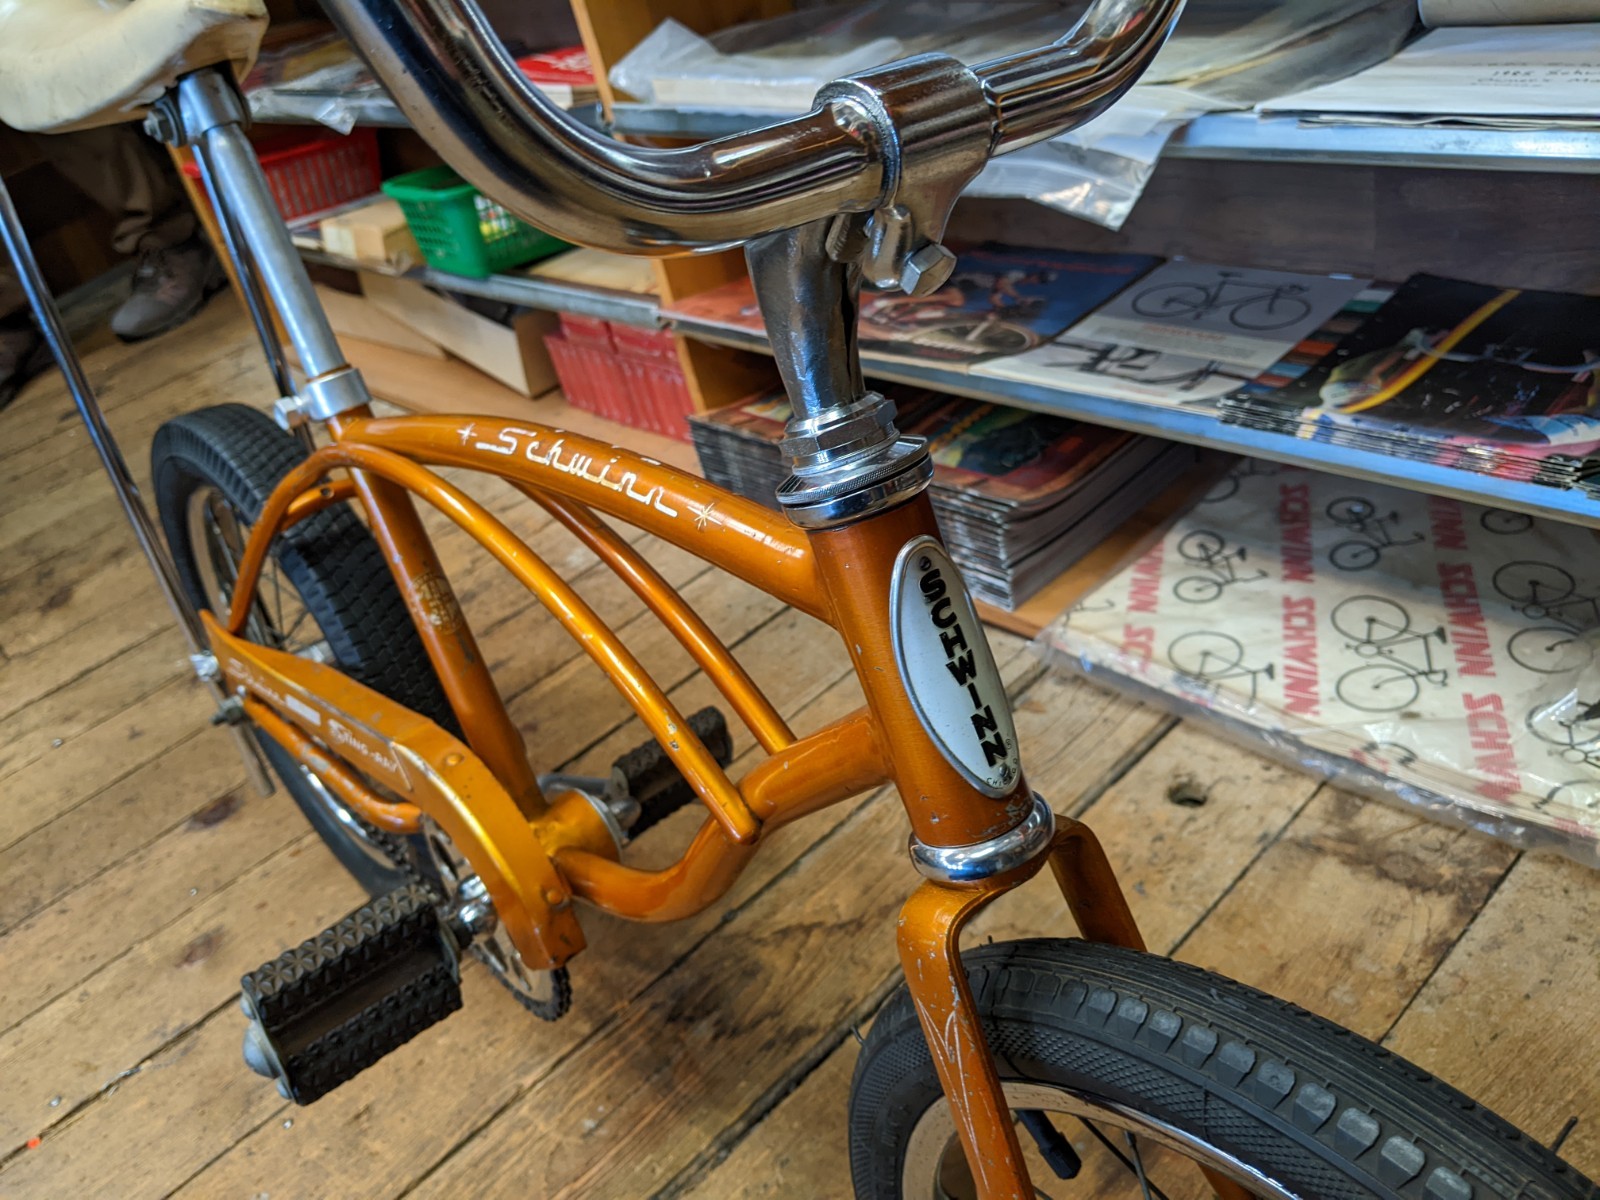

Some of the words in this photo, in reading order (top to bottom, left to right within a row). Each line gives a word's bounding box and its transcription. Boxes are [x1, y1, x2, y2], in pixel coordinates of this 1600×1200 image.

[475, 427, 678, 518] Schwinn
[1280, 483, 1315, 583] SCHWINN
[918, 568, 1008, 768] SCHWINN
[1282, 596, 1321, 717] SCHWINN
[1436, 562, 1497, 678] SCHWINN
